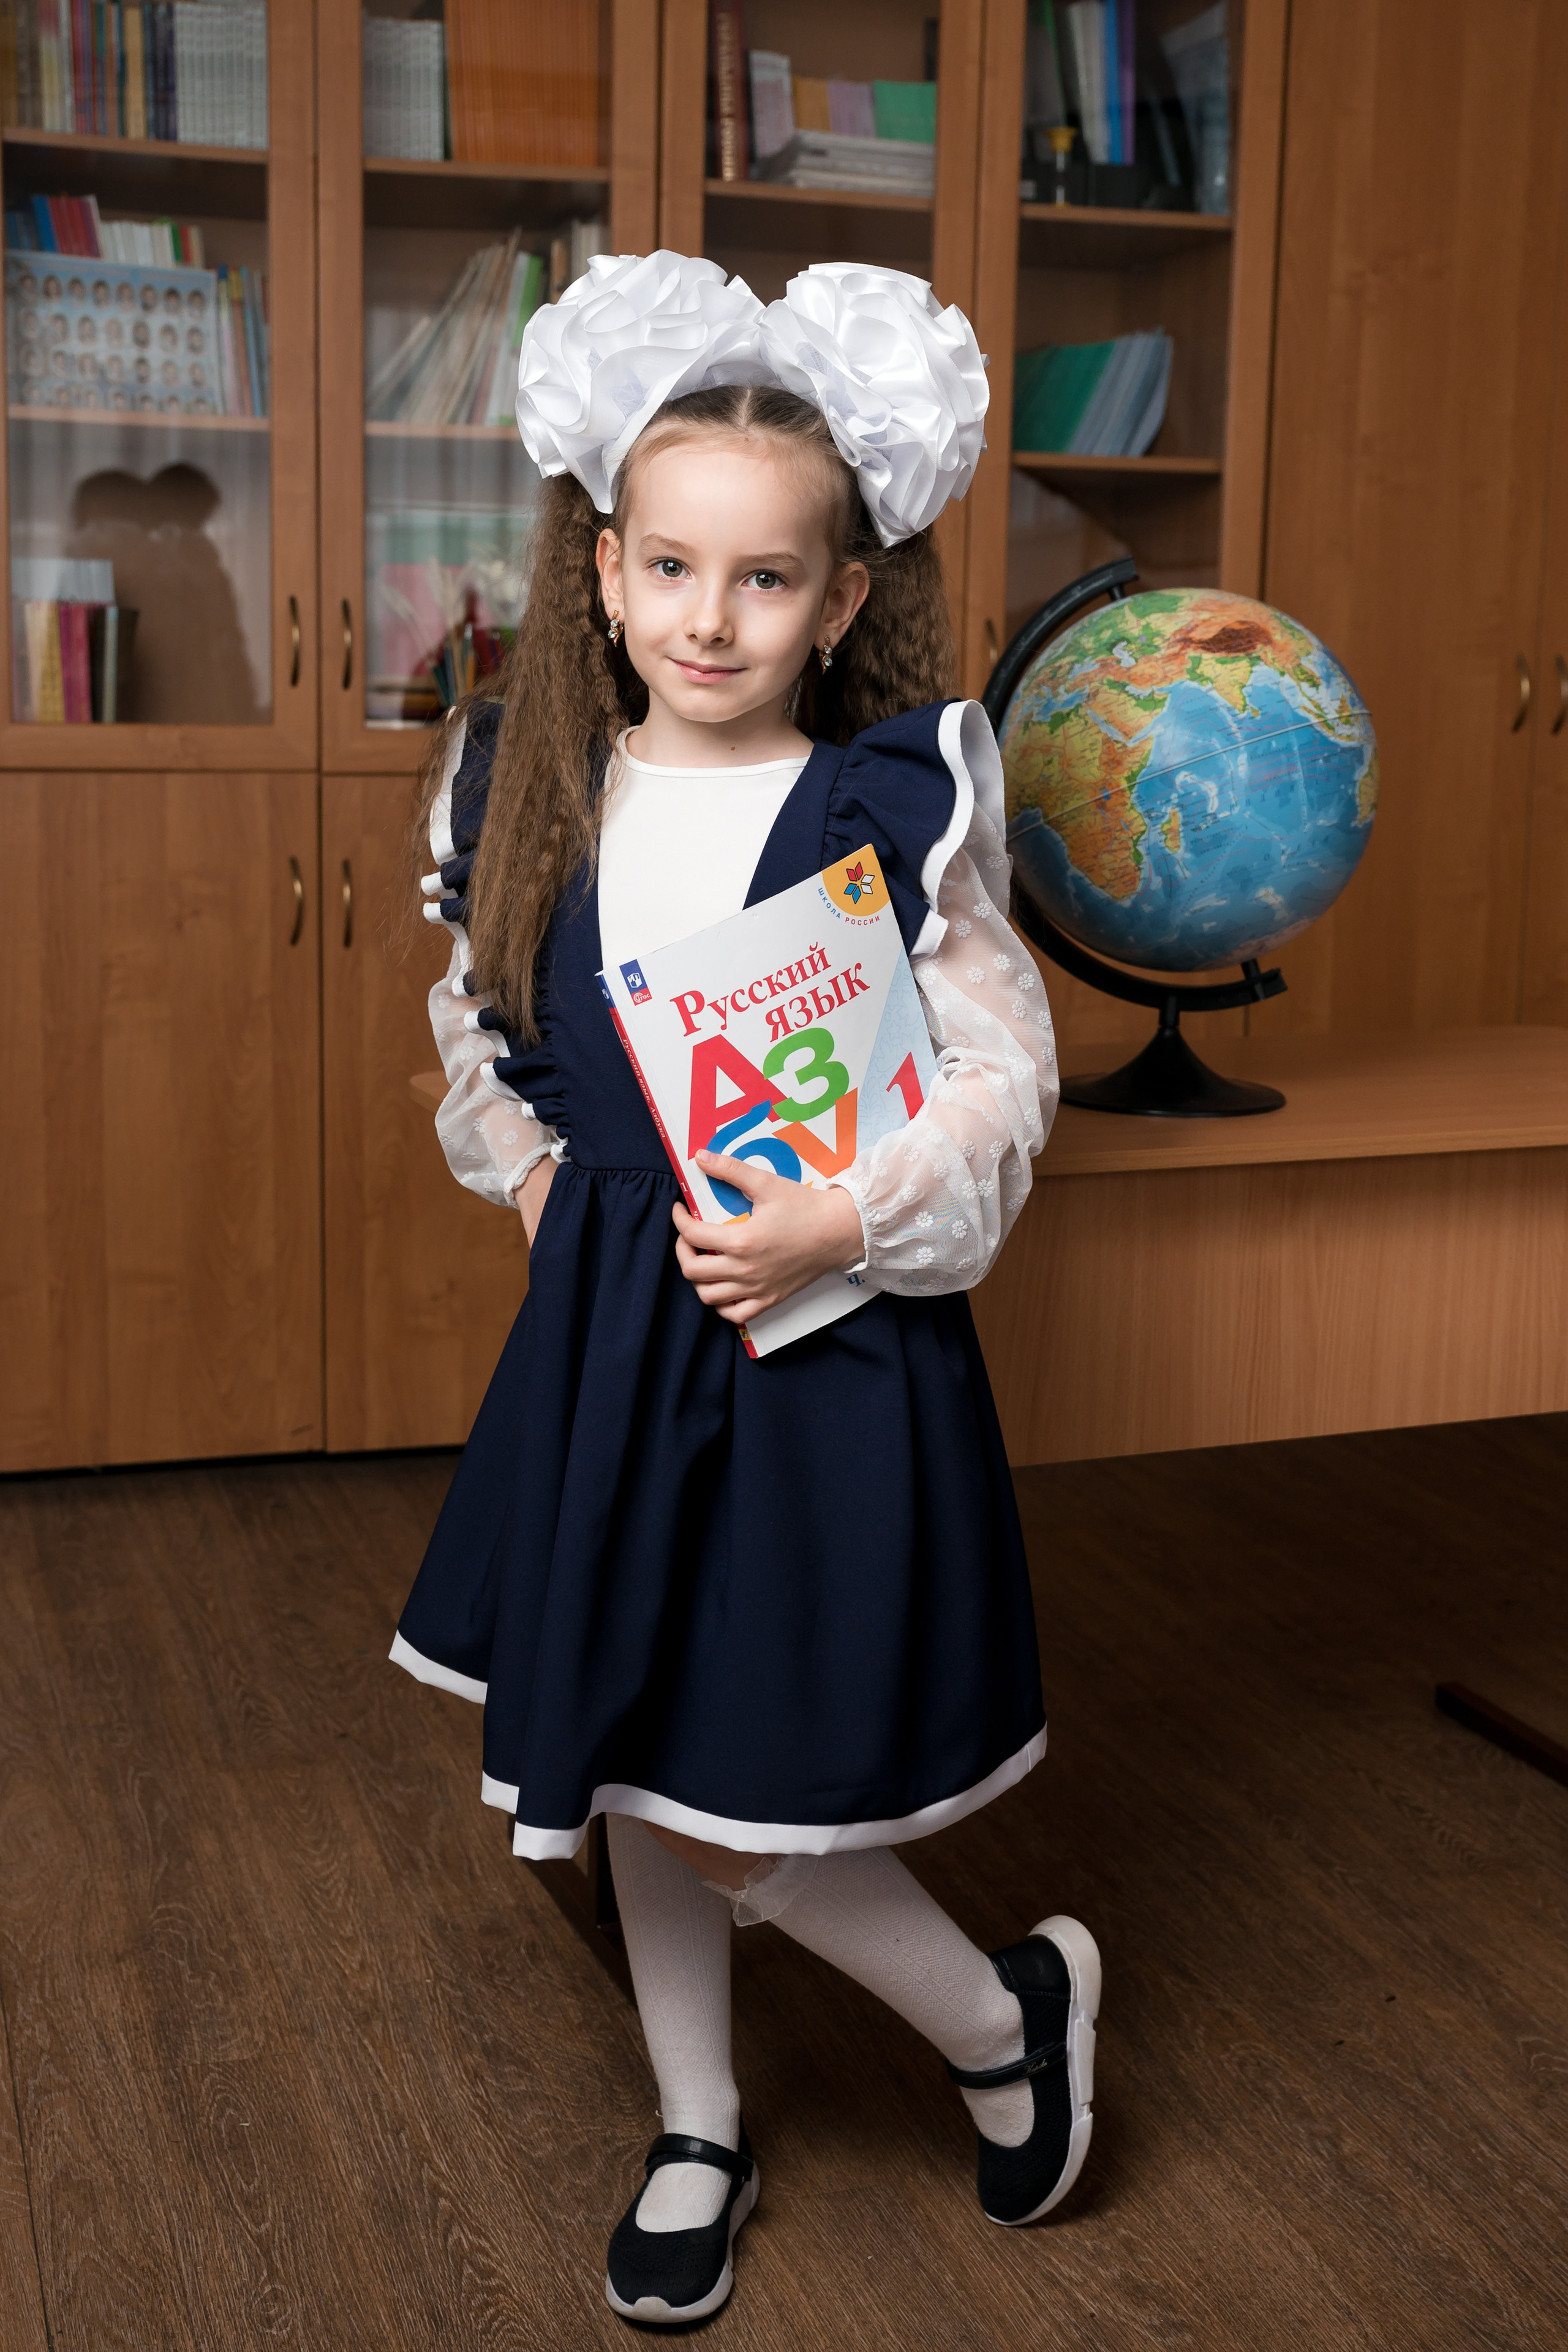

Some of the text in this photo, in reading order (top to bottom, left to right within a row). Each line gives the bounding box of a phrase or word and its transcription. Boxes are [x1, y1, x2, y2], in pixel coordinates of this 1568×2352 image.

[818, 888, 880, 926] ШКОЛА РОССИИ
[669, 941, 832, 1037] Русский
[886, 1051, 925, 1121] 1
